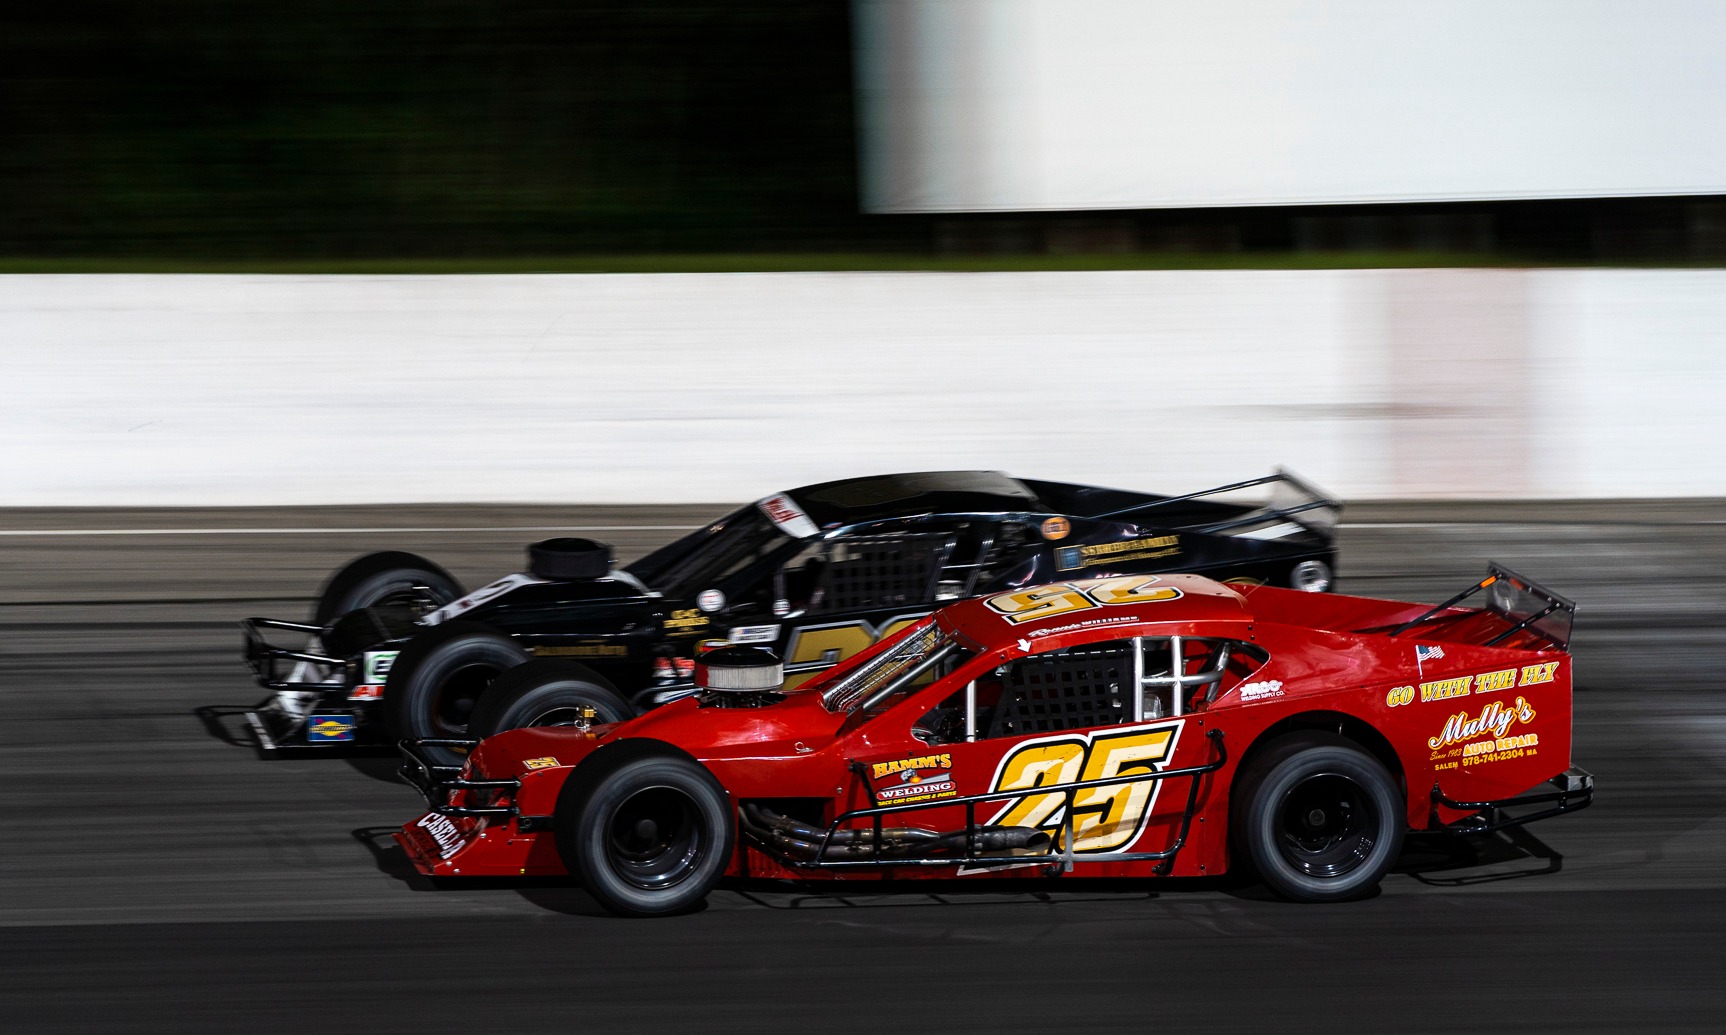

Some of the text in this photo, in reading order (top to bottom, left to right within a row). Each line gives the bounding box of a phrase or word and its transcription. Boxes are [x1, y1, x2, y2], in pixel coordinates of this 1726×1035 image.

[983, 574, 1184, 626] 25
[1386, 661, 1560, 707] GO WITH THE FLY
[1428, 696, 1536, 750] Mully's
[1429, 751, 1446, 761] Since
[1462, 734, 1539, 757] AUTO REPAIR
[522, 756, 561, 770] 25
[872, 753, 952, 779] HAMM'S
[1434, 748, 1538, 771] SALEM 978-741-2304 MA
[881, 782, 952, 799] WELDING
[906, 795, 931, 803] CHASSIS
[937, 790, 957, 798] PARTS
[957, 719, 1186, 876] 25
[416, 812, 467, 860] CASELLA
